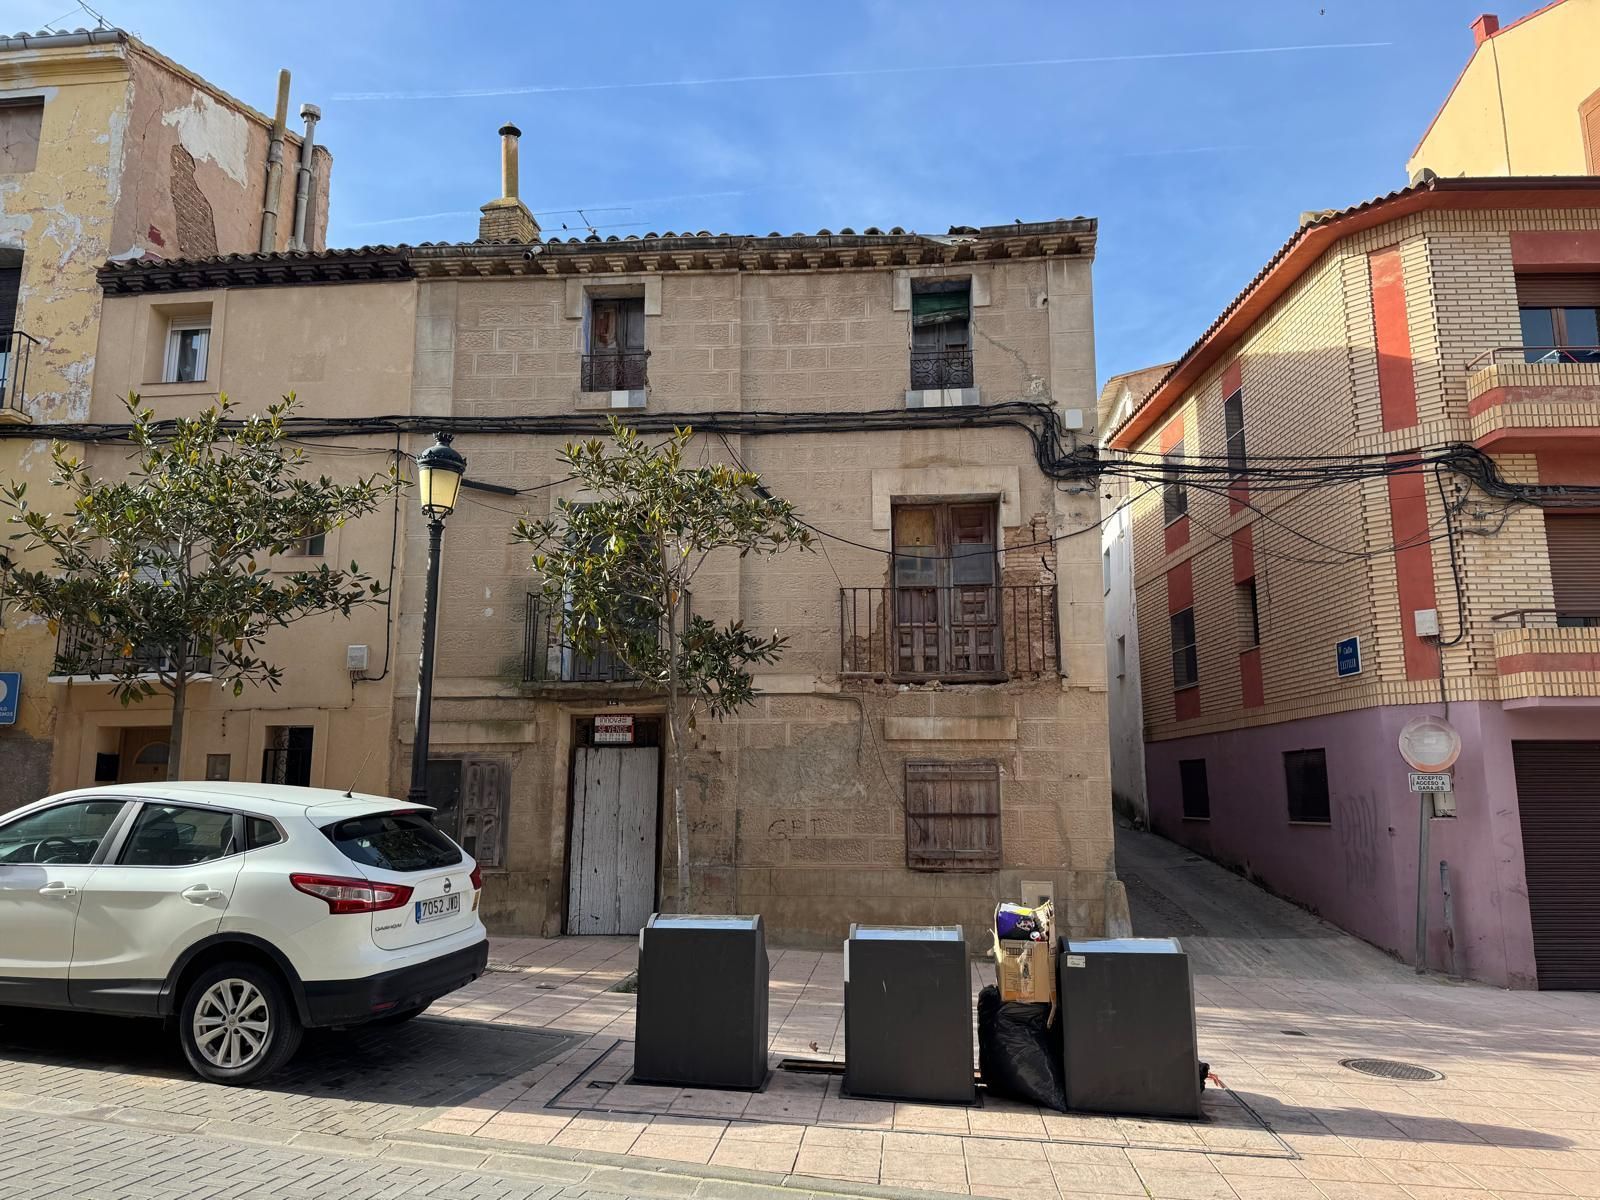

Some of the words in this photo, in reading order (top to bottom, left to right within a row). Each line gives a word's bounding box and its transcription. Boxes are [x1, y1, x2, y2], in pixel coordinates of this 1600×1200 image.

[599, 725, 607, 733] SE
[608, 725, 627, 733] VENDE
[422, 900, 444, 916] 7052
